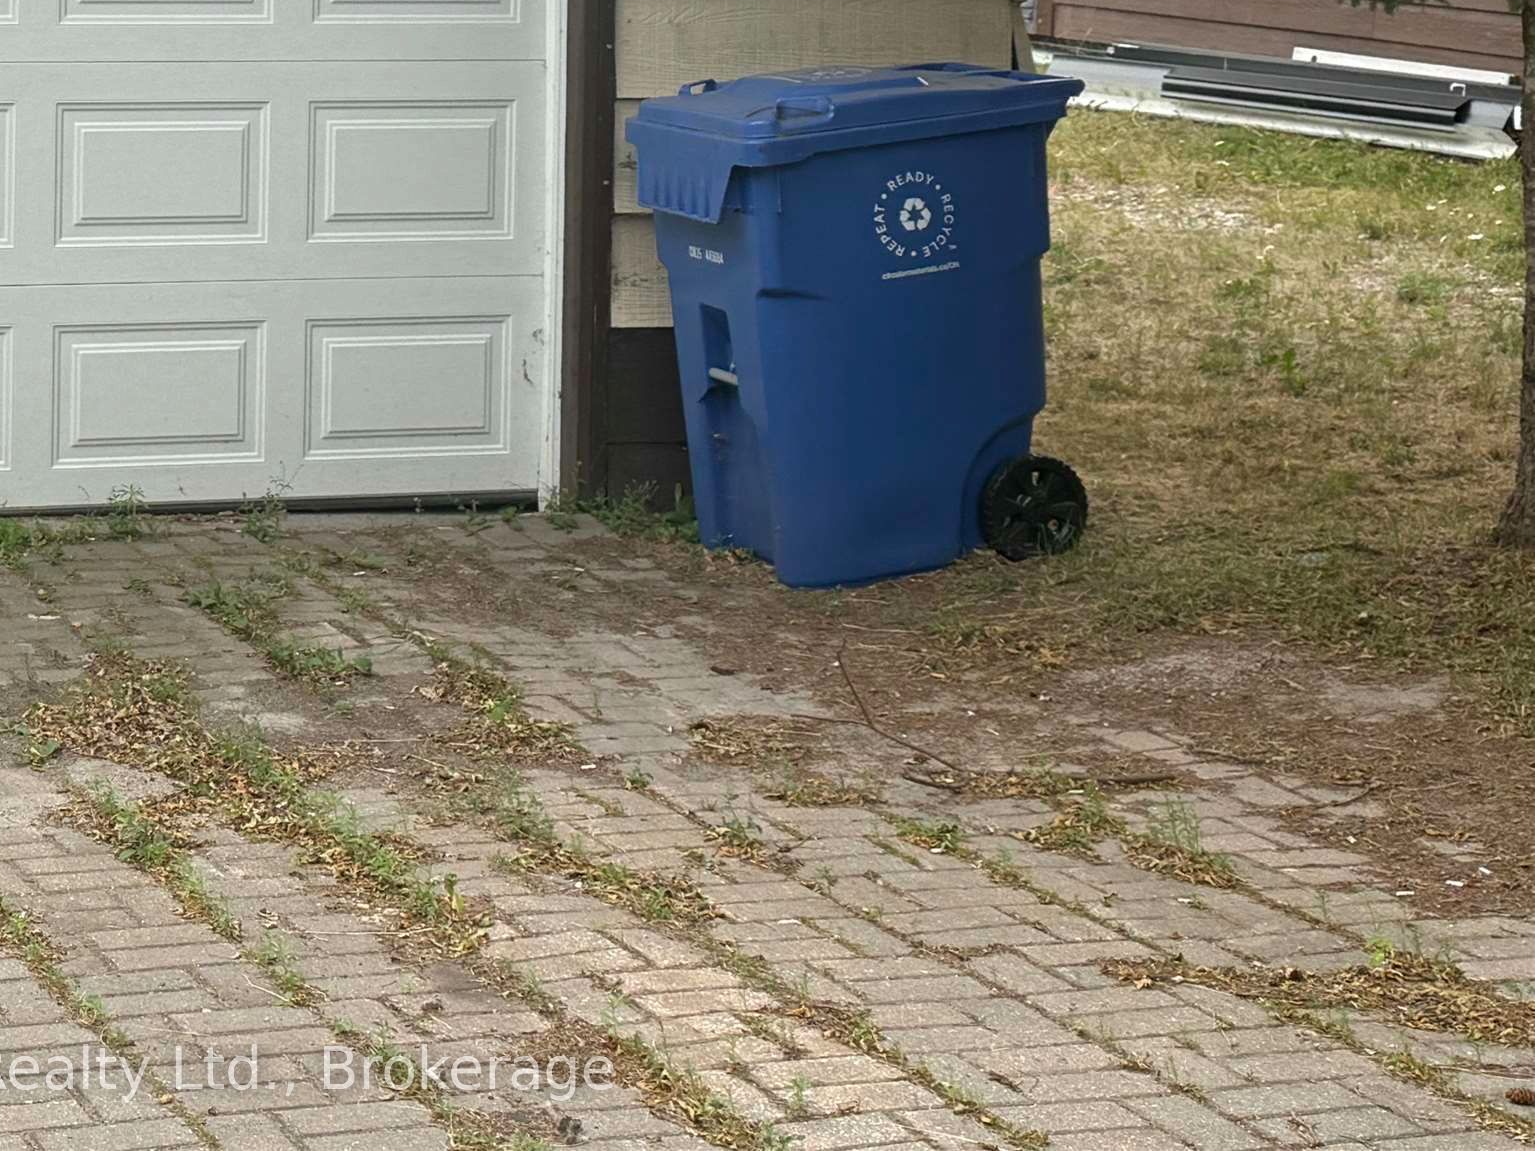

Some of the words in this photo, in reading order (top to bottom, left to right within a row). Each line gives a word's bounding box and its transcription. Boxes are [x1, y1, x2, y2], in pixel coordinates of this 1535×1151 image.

[887, 171, 934, 191] READY
[874, 203, 905, 257] REPEAT
[921, 193, 955, 258] RECYCLE
